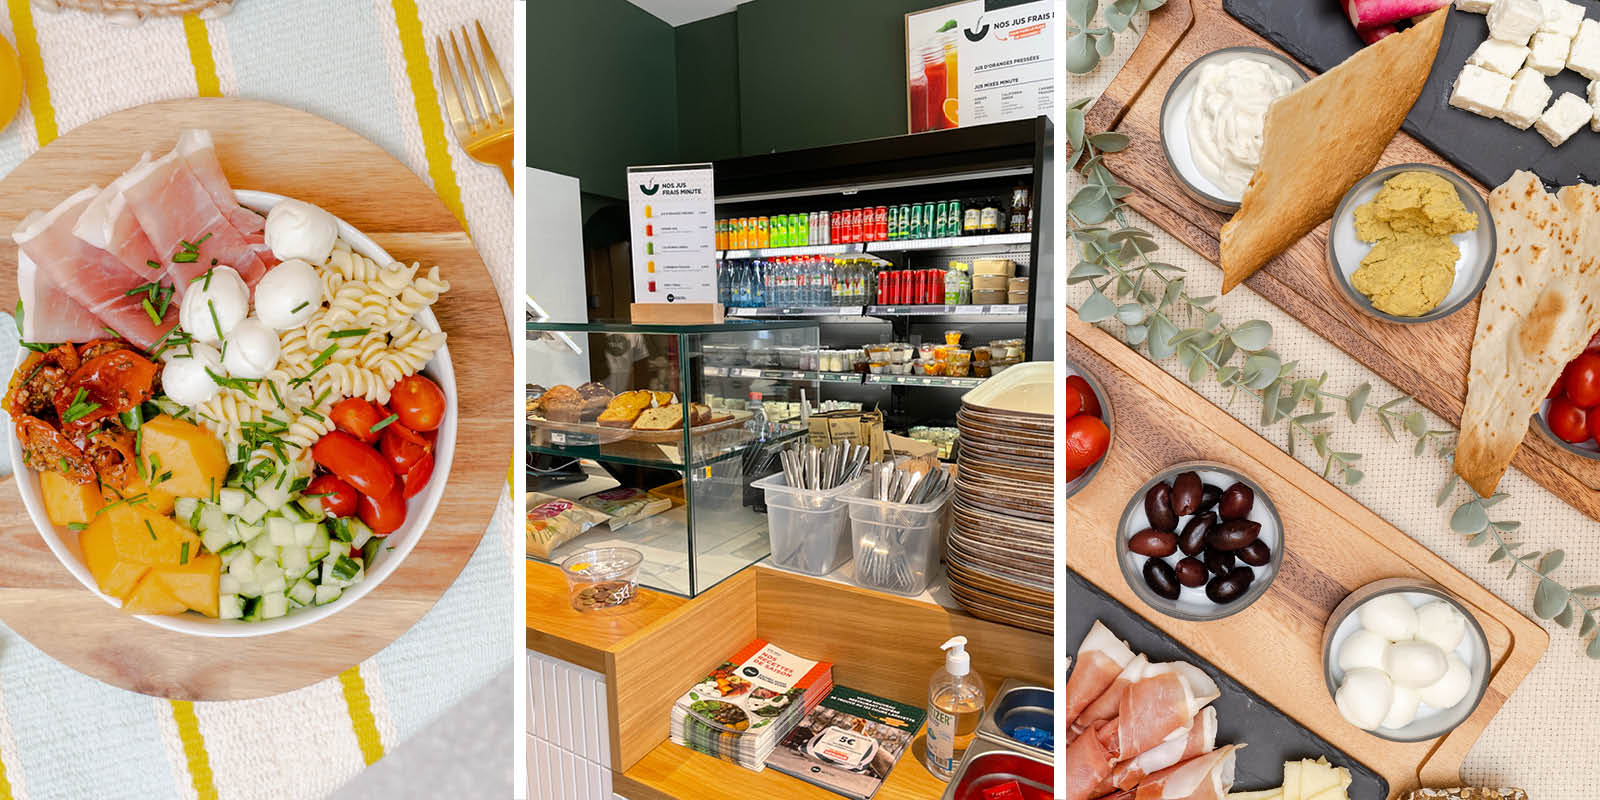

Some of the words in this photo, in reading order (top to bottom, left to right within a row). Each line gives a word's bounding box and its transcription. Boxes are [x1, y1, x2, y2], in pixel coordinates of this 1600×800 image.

[993, 20, 1010, 30] NOS
[1011, 17, 1026, 26] JUS
[1027, 12, 1051, 23] FRAIS
[758, 655, 793, 673] RECETTES
[762, 651, 777, 661] NOS
[753, 658, 764, 666] DE
[764, 664, 792, 678] SAISON
[839, 736, 856, 745] 5€
